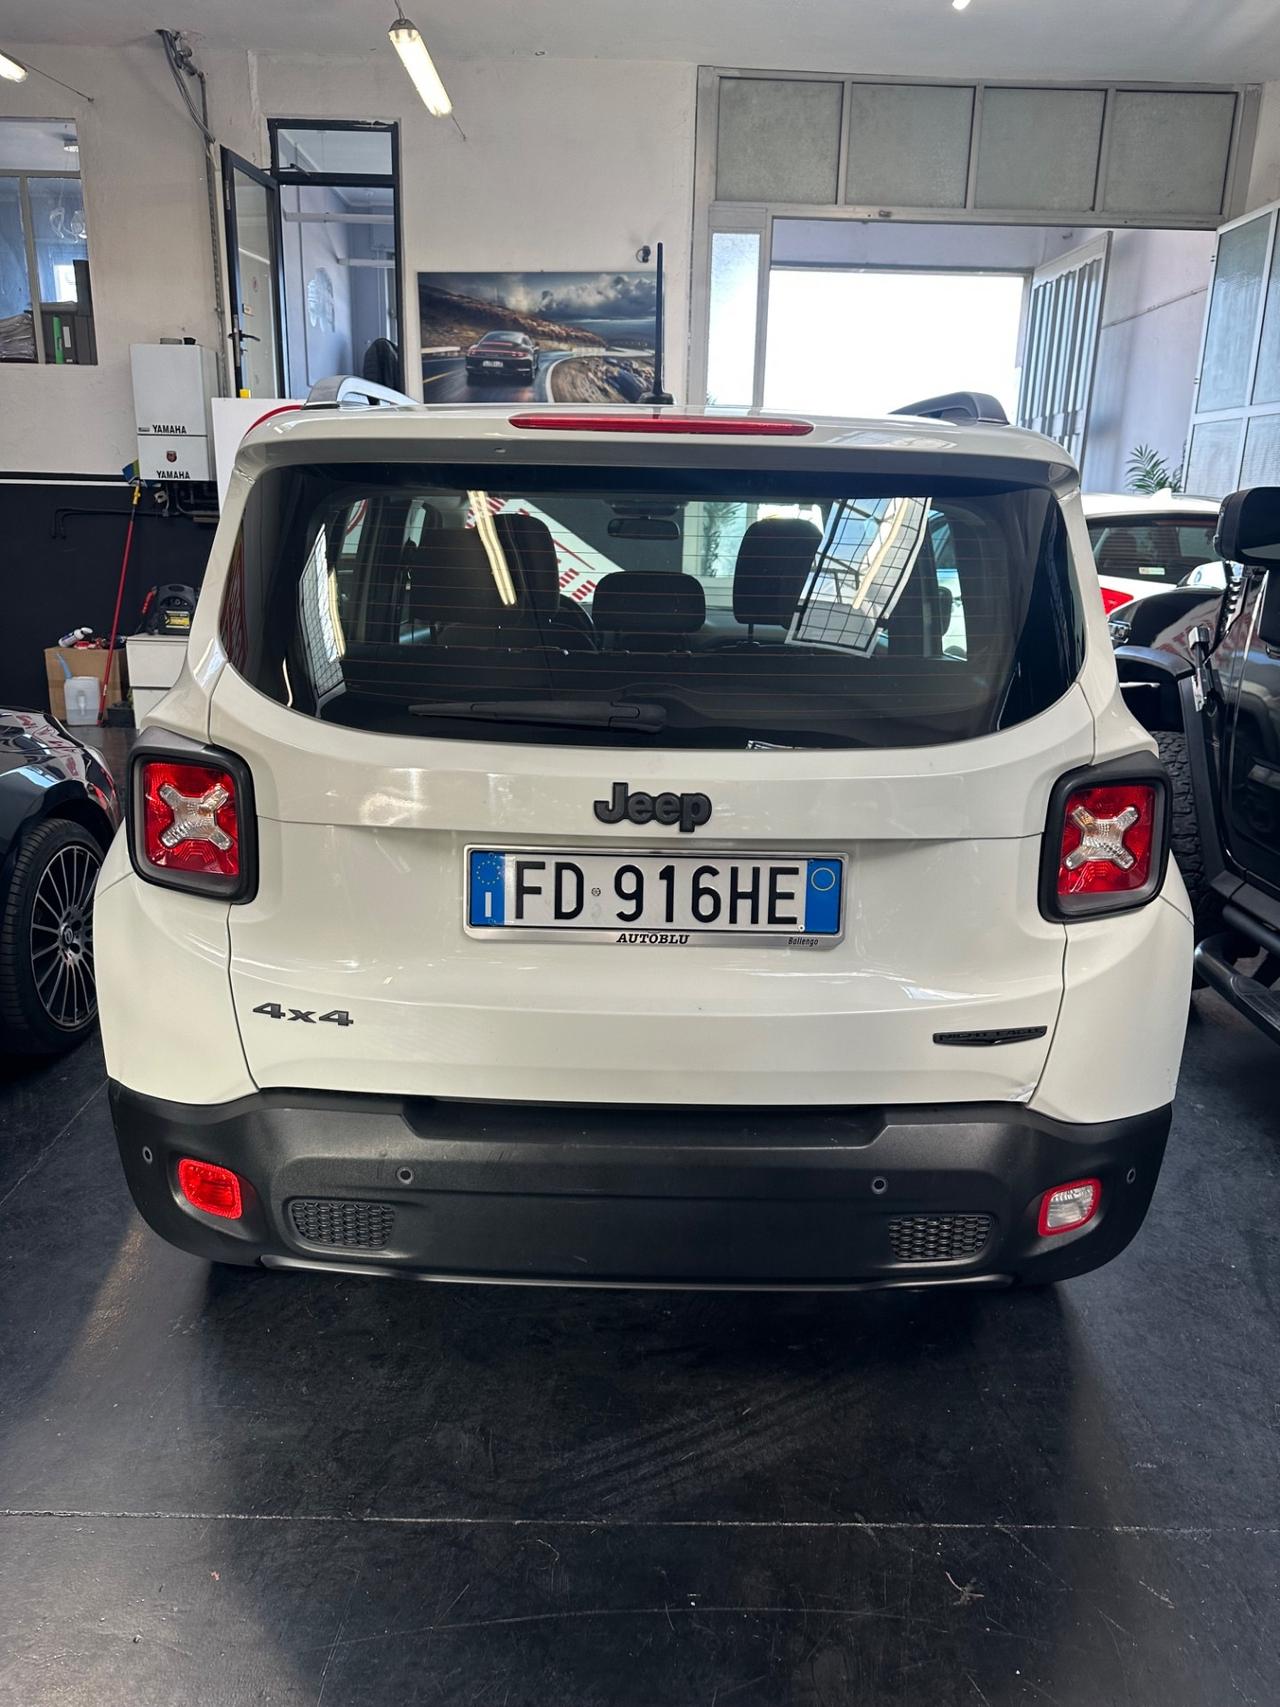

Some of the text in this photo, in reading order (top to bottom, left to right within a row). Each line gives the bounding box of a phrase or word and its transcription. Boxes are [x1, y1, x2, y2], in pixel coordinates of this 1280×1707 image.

[152, 424, 187, 434] YAMAHA
[156, 470, 191, 479] YAMAHA
[593, 782, 712, 832] Jeep
[616, 932, 690, 945] AUTOBLU
[253, 1003, 353, 1026] 4x4
